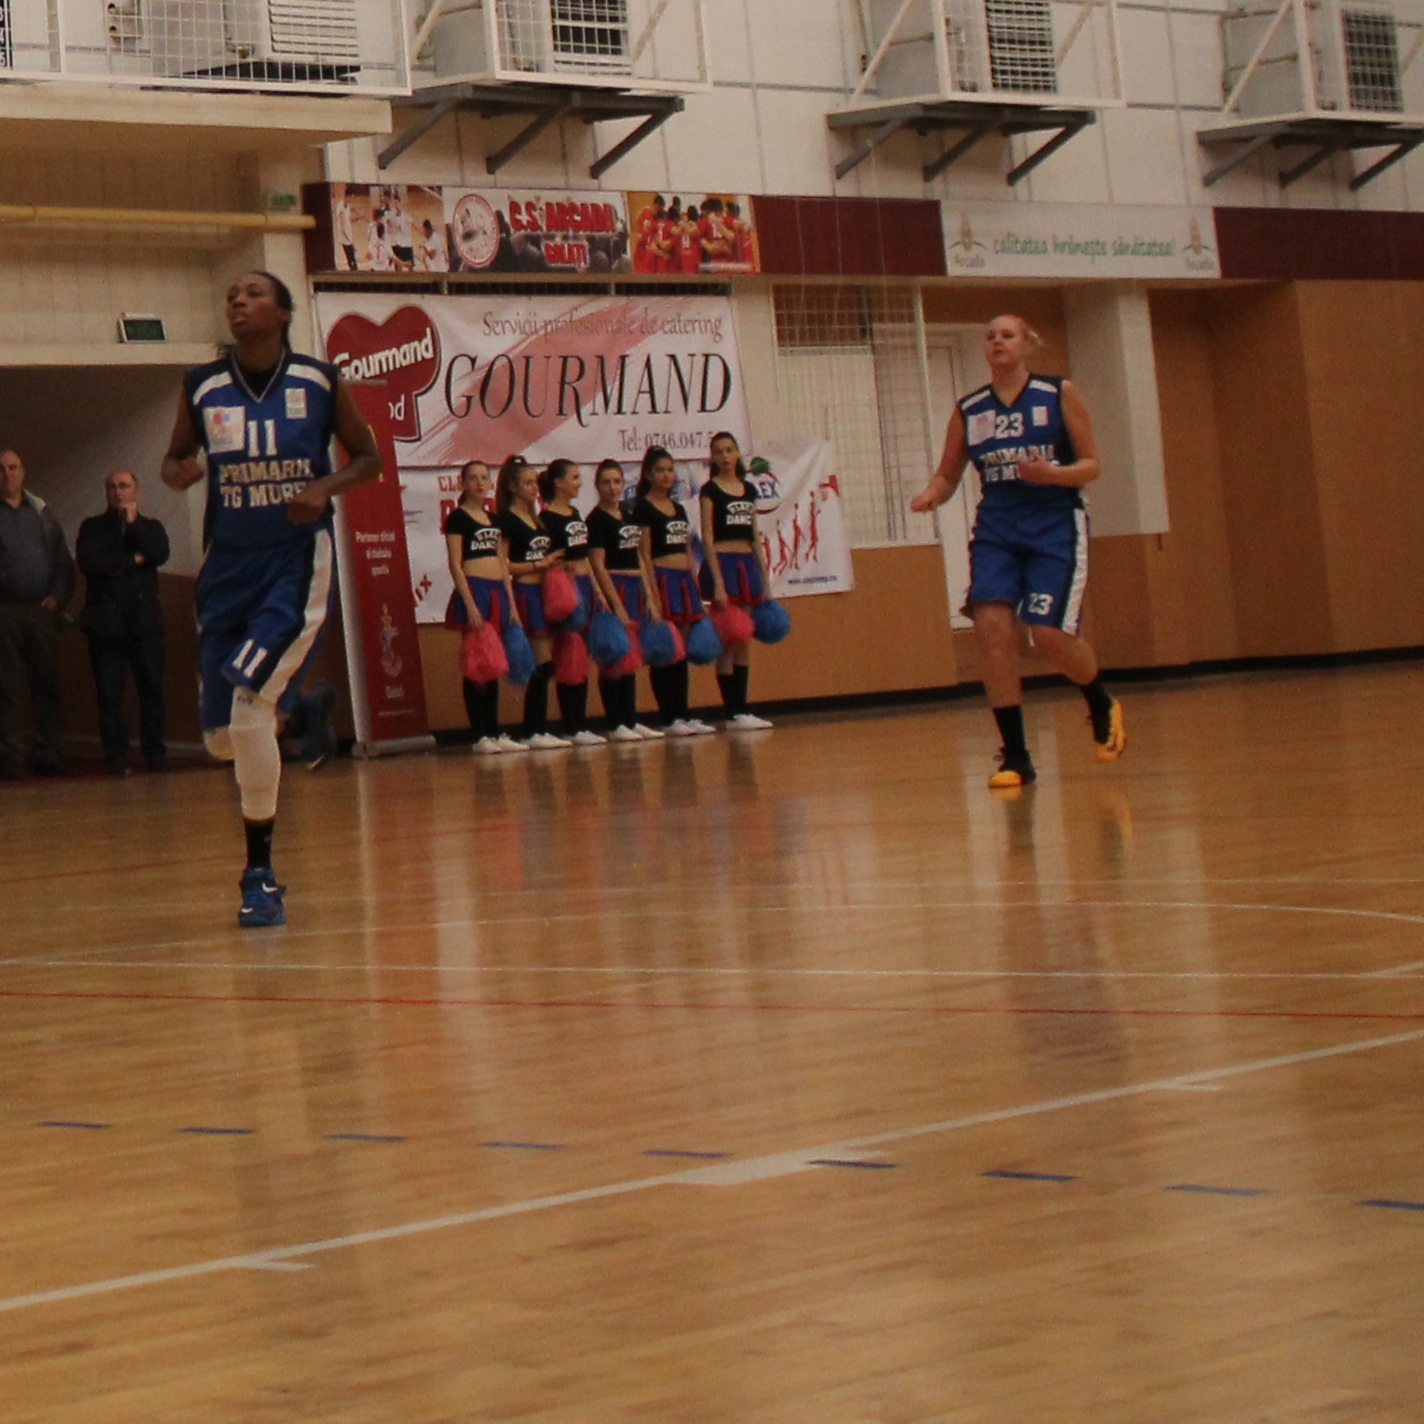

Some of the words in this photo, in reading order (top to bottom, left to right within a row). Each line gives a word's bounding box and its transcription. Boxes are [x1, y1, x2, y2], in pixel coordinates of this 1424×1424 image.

[660, 314, 722, 343] catering
[333, 327, 434, 381] Gourmand
[445, 352, 732, 428] GOURMAND
[247, 419, 277, 458] 11
[995, 412, 1024, 440] 23
[232, 639, 268, 678] 11
